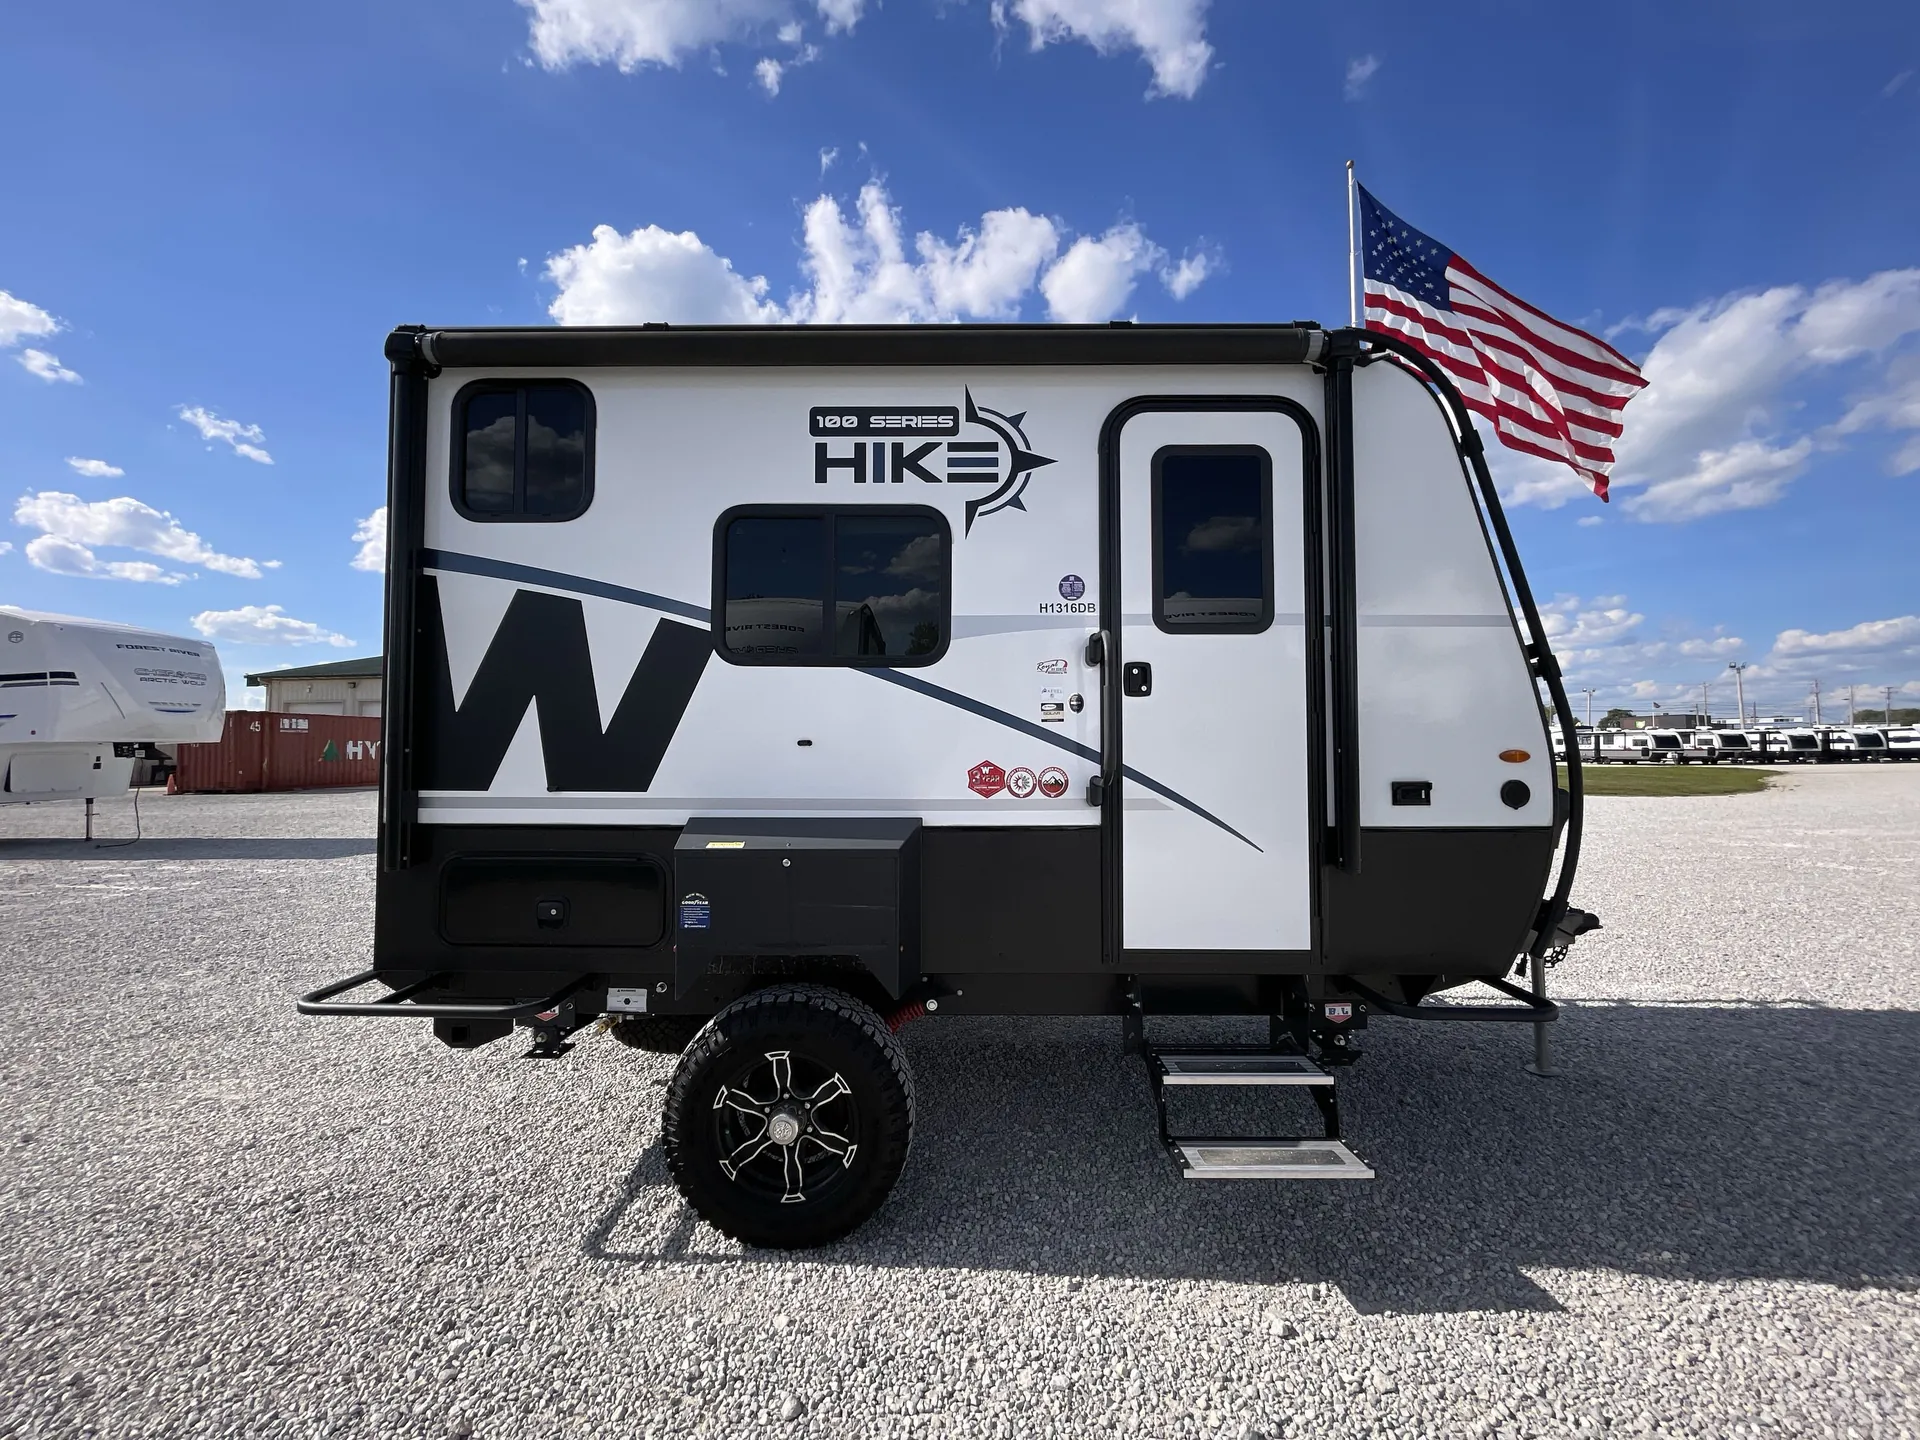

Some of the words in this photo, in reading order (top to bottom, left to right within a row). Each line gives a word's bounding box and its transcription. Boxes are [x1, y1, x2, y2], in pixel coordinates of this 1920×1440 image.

[816, 415, 858, 428] 100
[869, 415, 954, 428] SERIES
[814, 441, 999, 484] HIKE
[1039, 603, 1096, 613] H1316DB
[116, 644, 166, 652] FOREST
[168, 648, 200, 657] RIVER
[249, 721, 261, 731] 45
